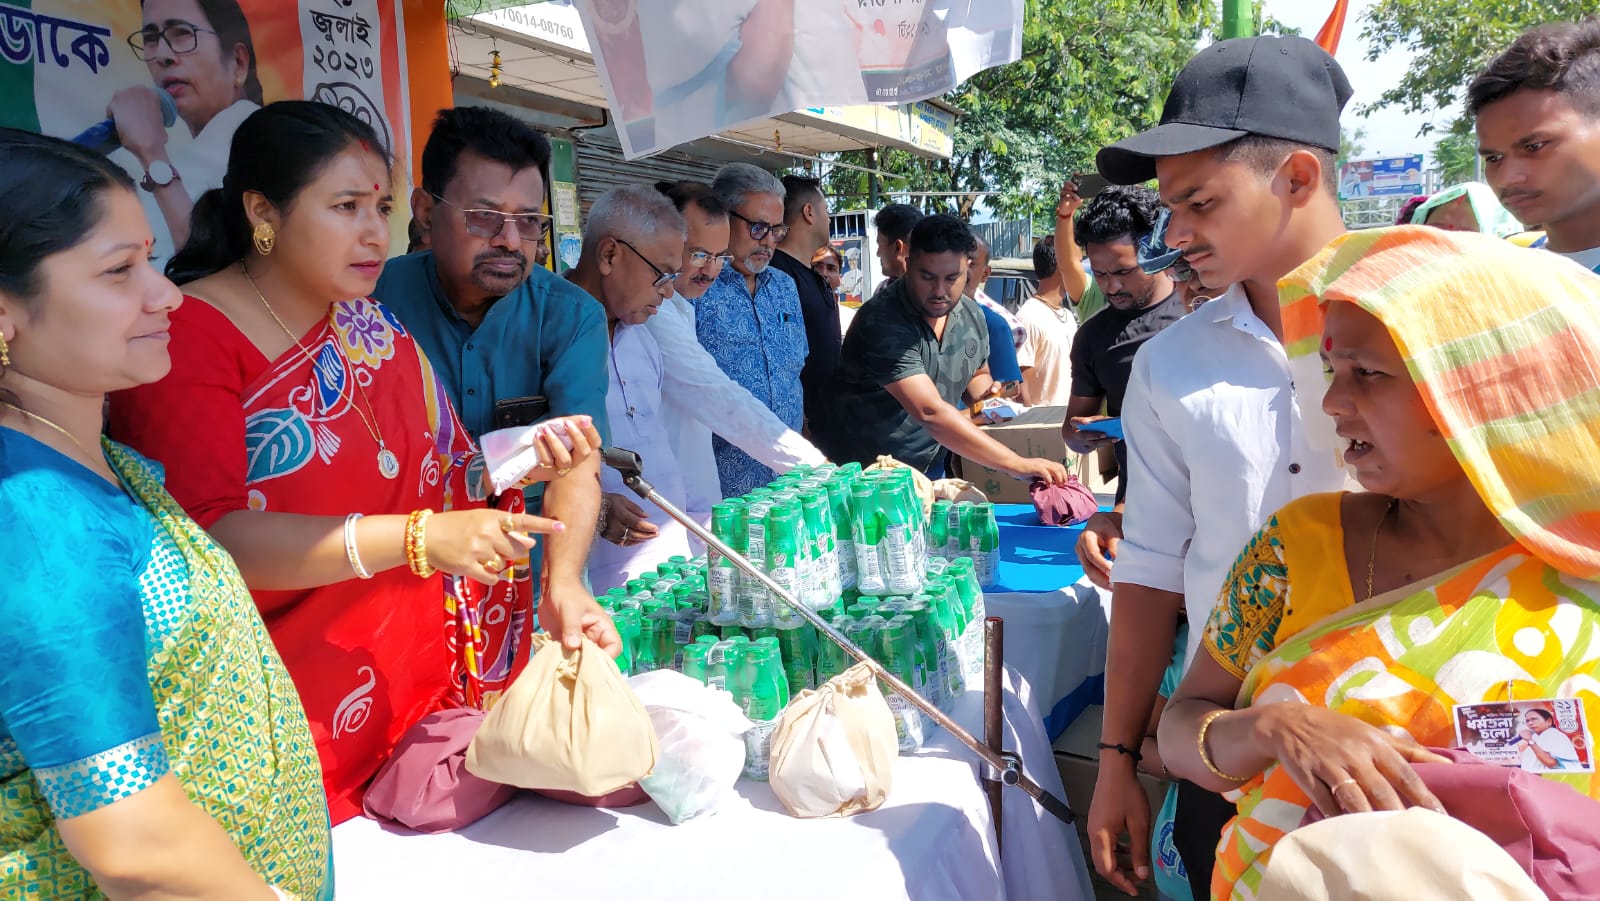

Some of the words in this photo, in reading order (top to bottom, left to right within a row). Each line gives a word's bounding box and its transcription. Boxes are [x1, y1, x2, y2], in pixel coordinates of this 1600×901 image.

[309, 10, 372, 48] জুলাই
[312, 44, 374, 80] ২০২৩
[1466, 715, 1514, 730] ধর্মতলা
[1480, 729, 1510, 739] চলো
